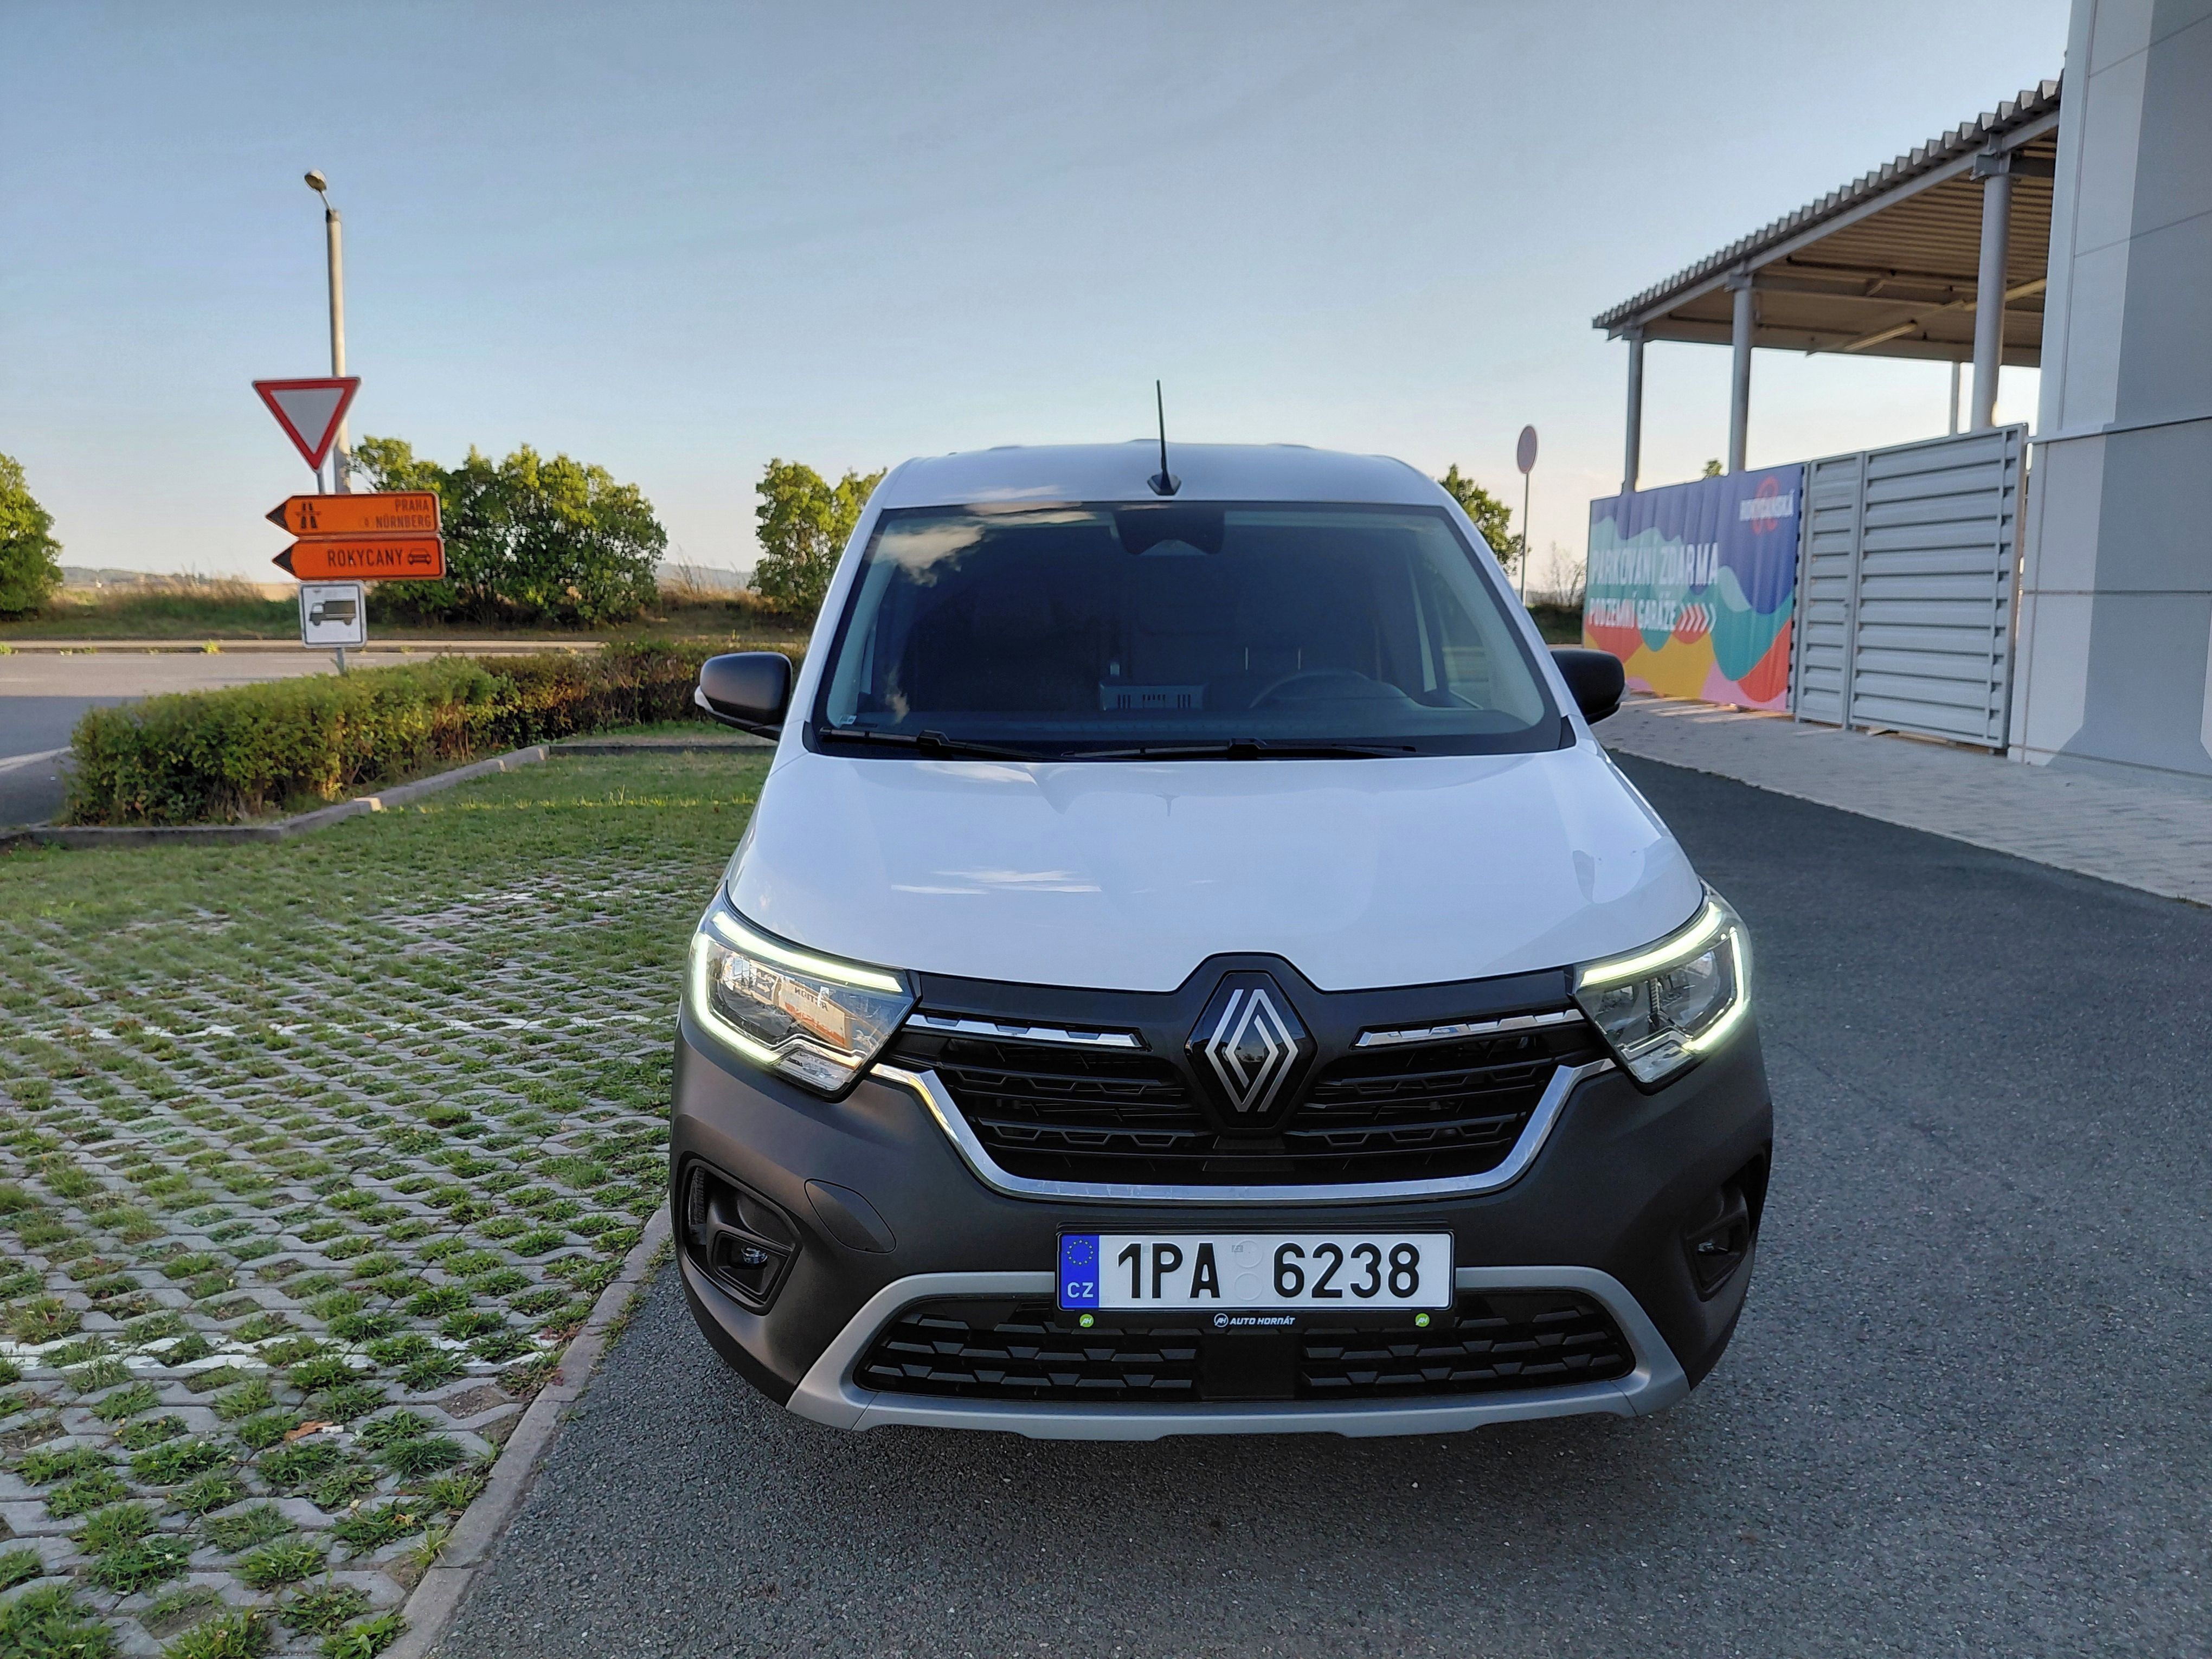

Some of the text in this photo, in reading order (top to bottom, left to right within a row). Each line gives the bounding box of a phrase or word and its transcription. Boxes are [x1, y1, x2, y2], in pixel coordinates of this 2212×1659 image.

[395, 498, 429, 512] PRAHA
[376, 513, 432, 528] NÜRNBERG
[327, 548, 403, 567] ROKYCANY
[1660, 543, 1718, 585] ZDARMA
[1117, 1243, 1420, 1298] 1PA 6238
[1067, 1282, 1094, 1298] CZ
